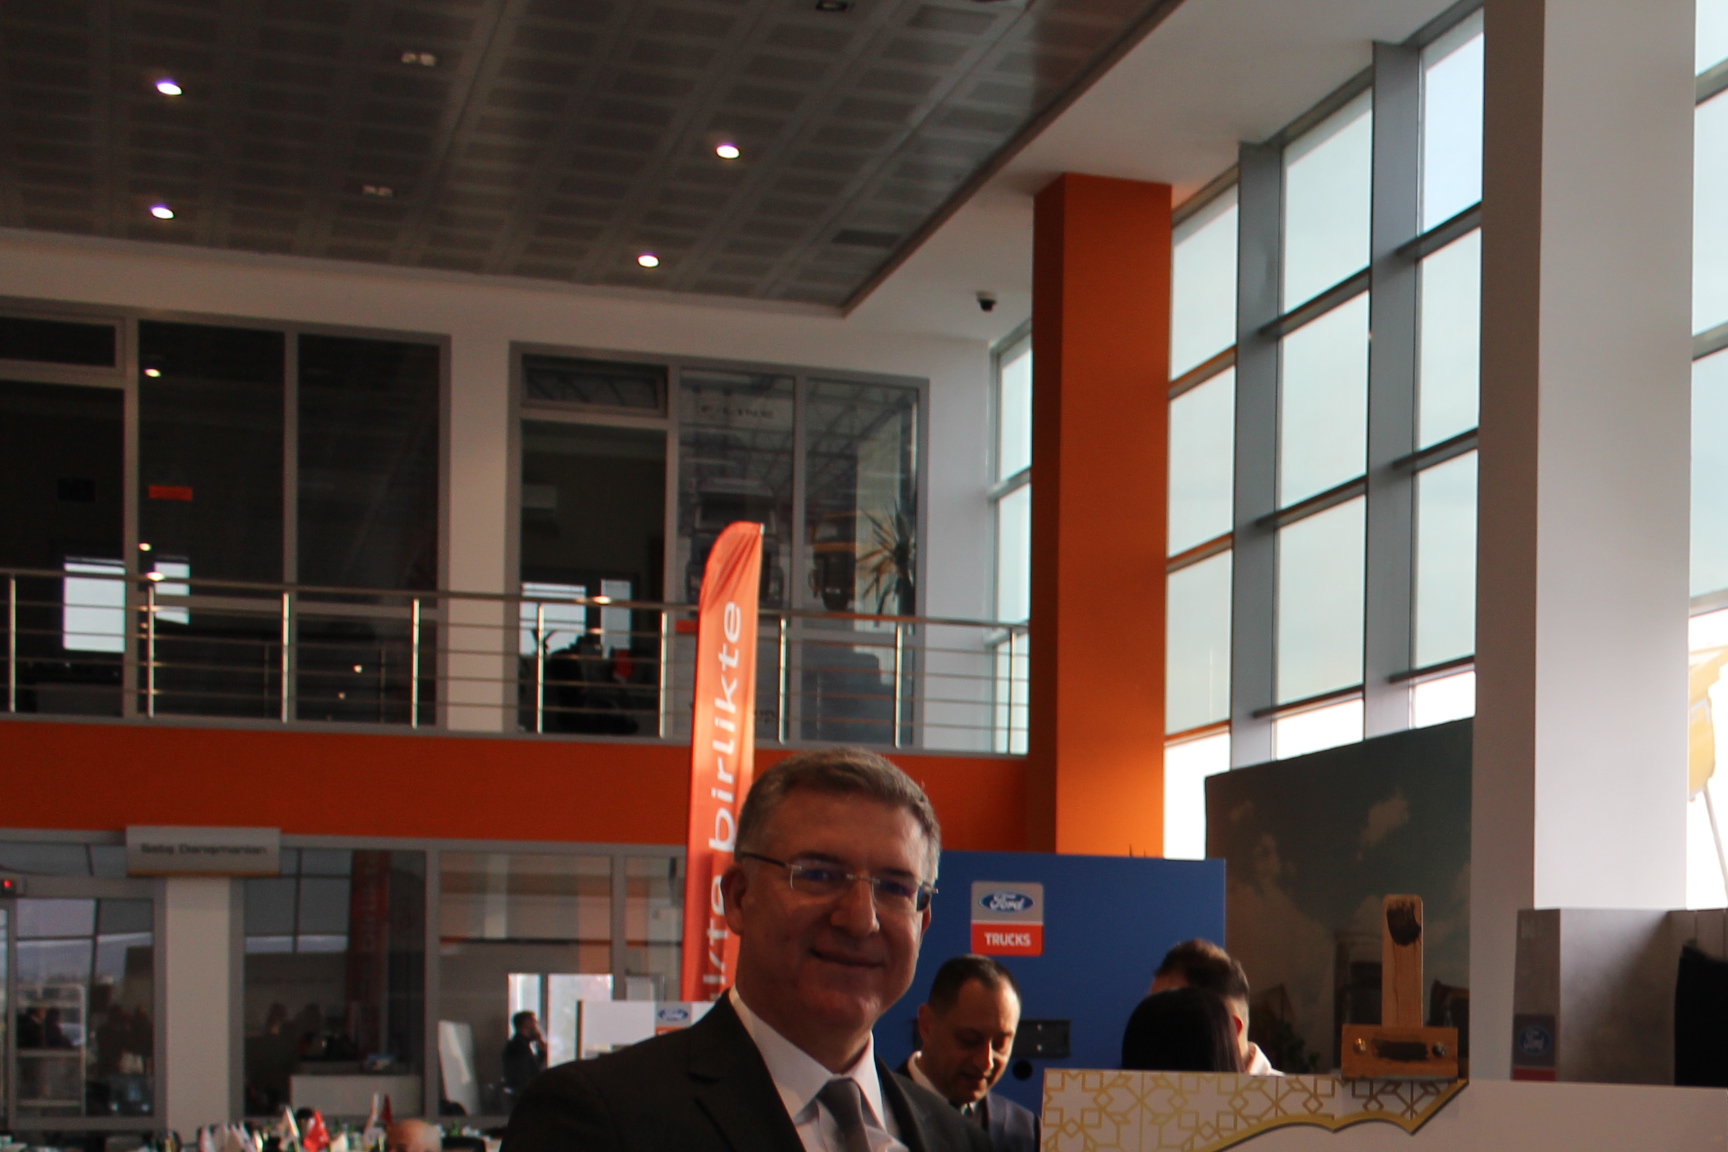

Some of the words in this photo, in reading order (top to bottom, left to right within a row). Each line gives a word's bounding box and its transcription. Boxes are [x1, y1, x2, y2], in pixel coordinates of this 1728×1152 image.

[708, 602, 742, 852] birlikte
[989, 893, 1026, 911] Ford
[984, 931, 1033, 947] TRUCKS
